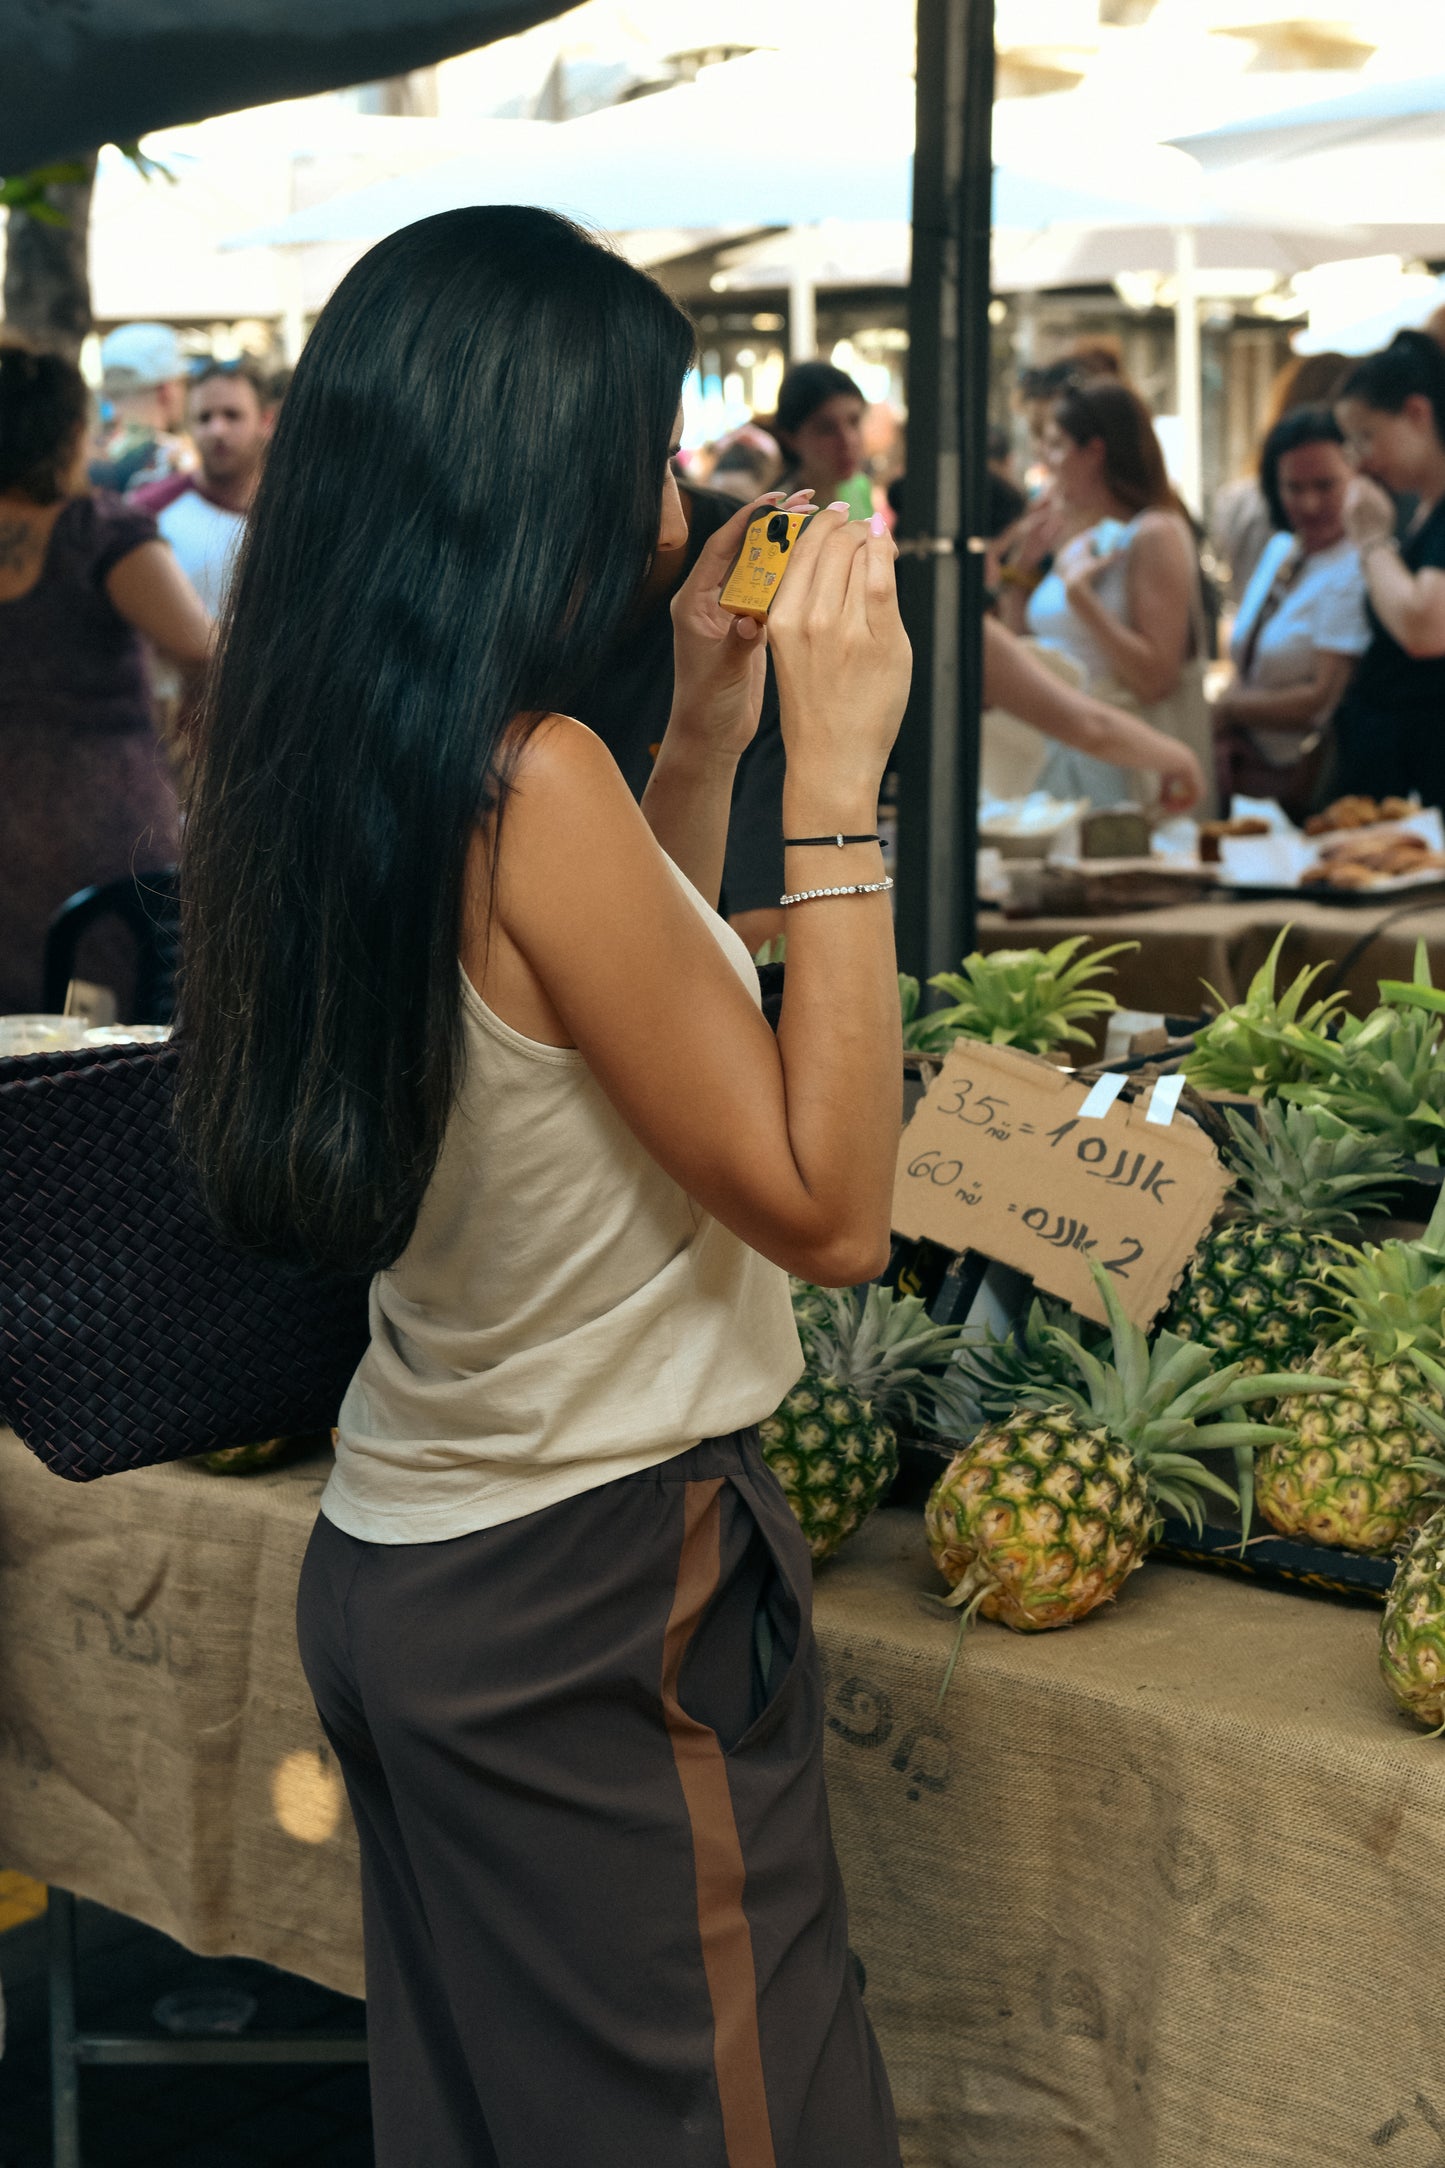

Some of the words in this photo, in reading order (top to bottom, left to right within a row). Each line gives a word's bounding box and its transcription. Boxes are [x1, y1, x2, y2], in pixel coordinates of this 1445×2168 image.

[937, 1078, 1010, 1126] 35
[1045, 1118, 1081, 1148] 1
[1076, 1136, 1176, 1205] אננס
[907, 1150, 964, 1186] 60
[1021, 1206, 1099, 1253] אננס
[1102, 1236, 1145, 1280] 2
